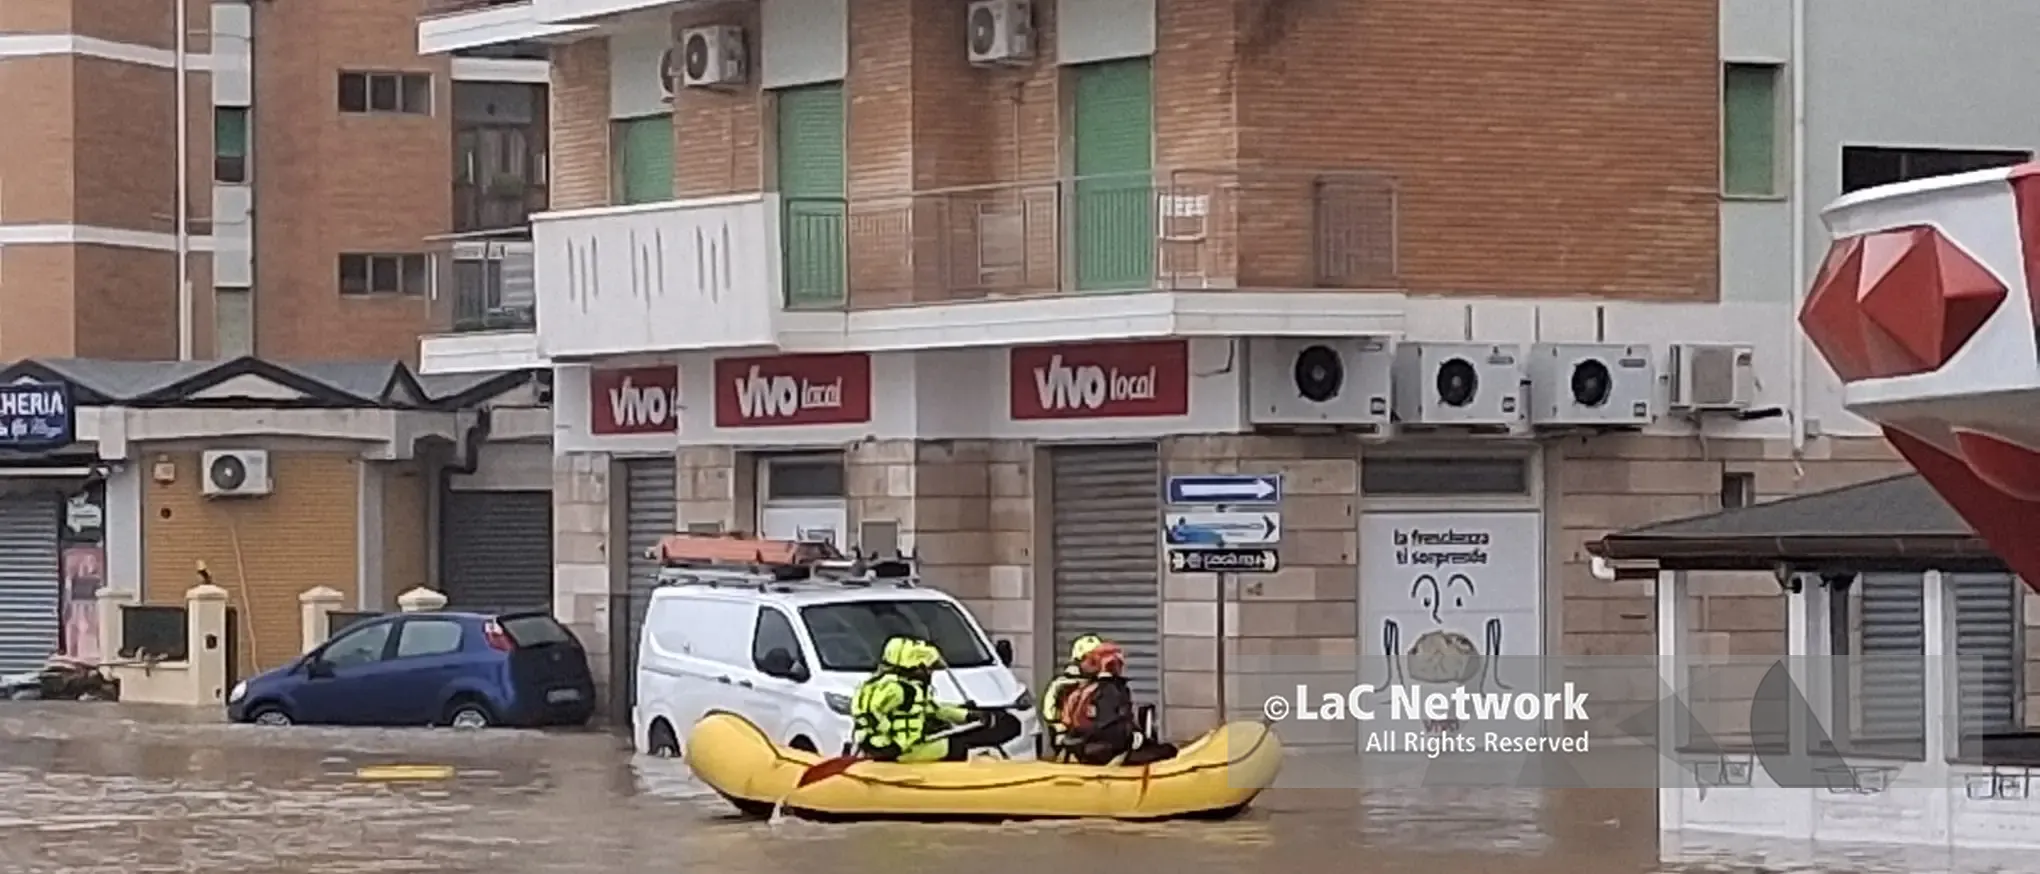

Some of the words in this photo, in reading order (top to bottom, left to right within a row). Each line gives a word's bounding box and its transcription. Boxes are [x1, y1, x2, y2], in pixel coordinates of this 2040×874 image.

[801, 376, 842, 409] local
[1110, 366, 1157, 401] local
[0, 391, 64, 416] HERIA
